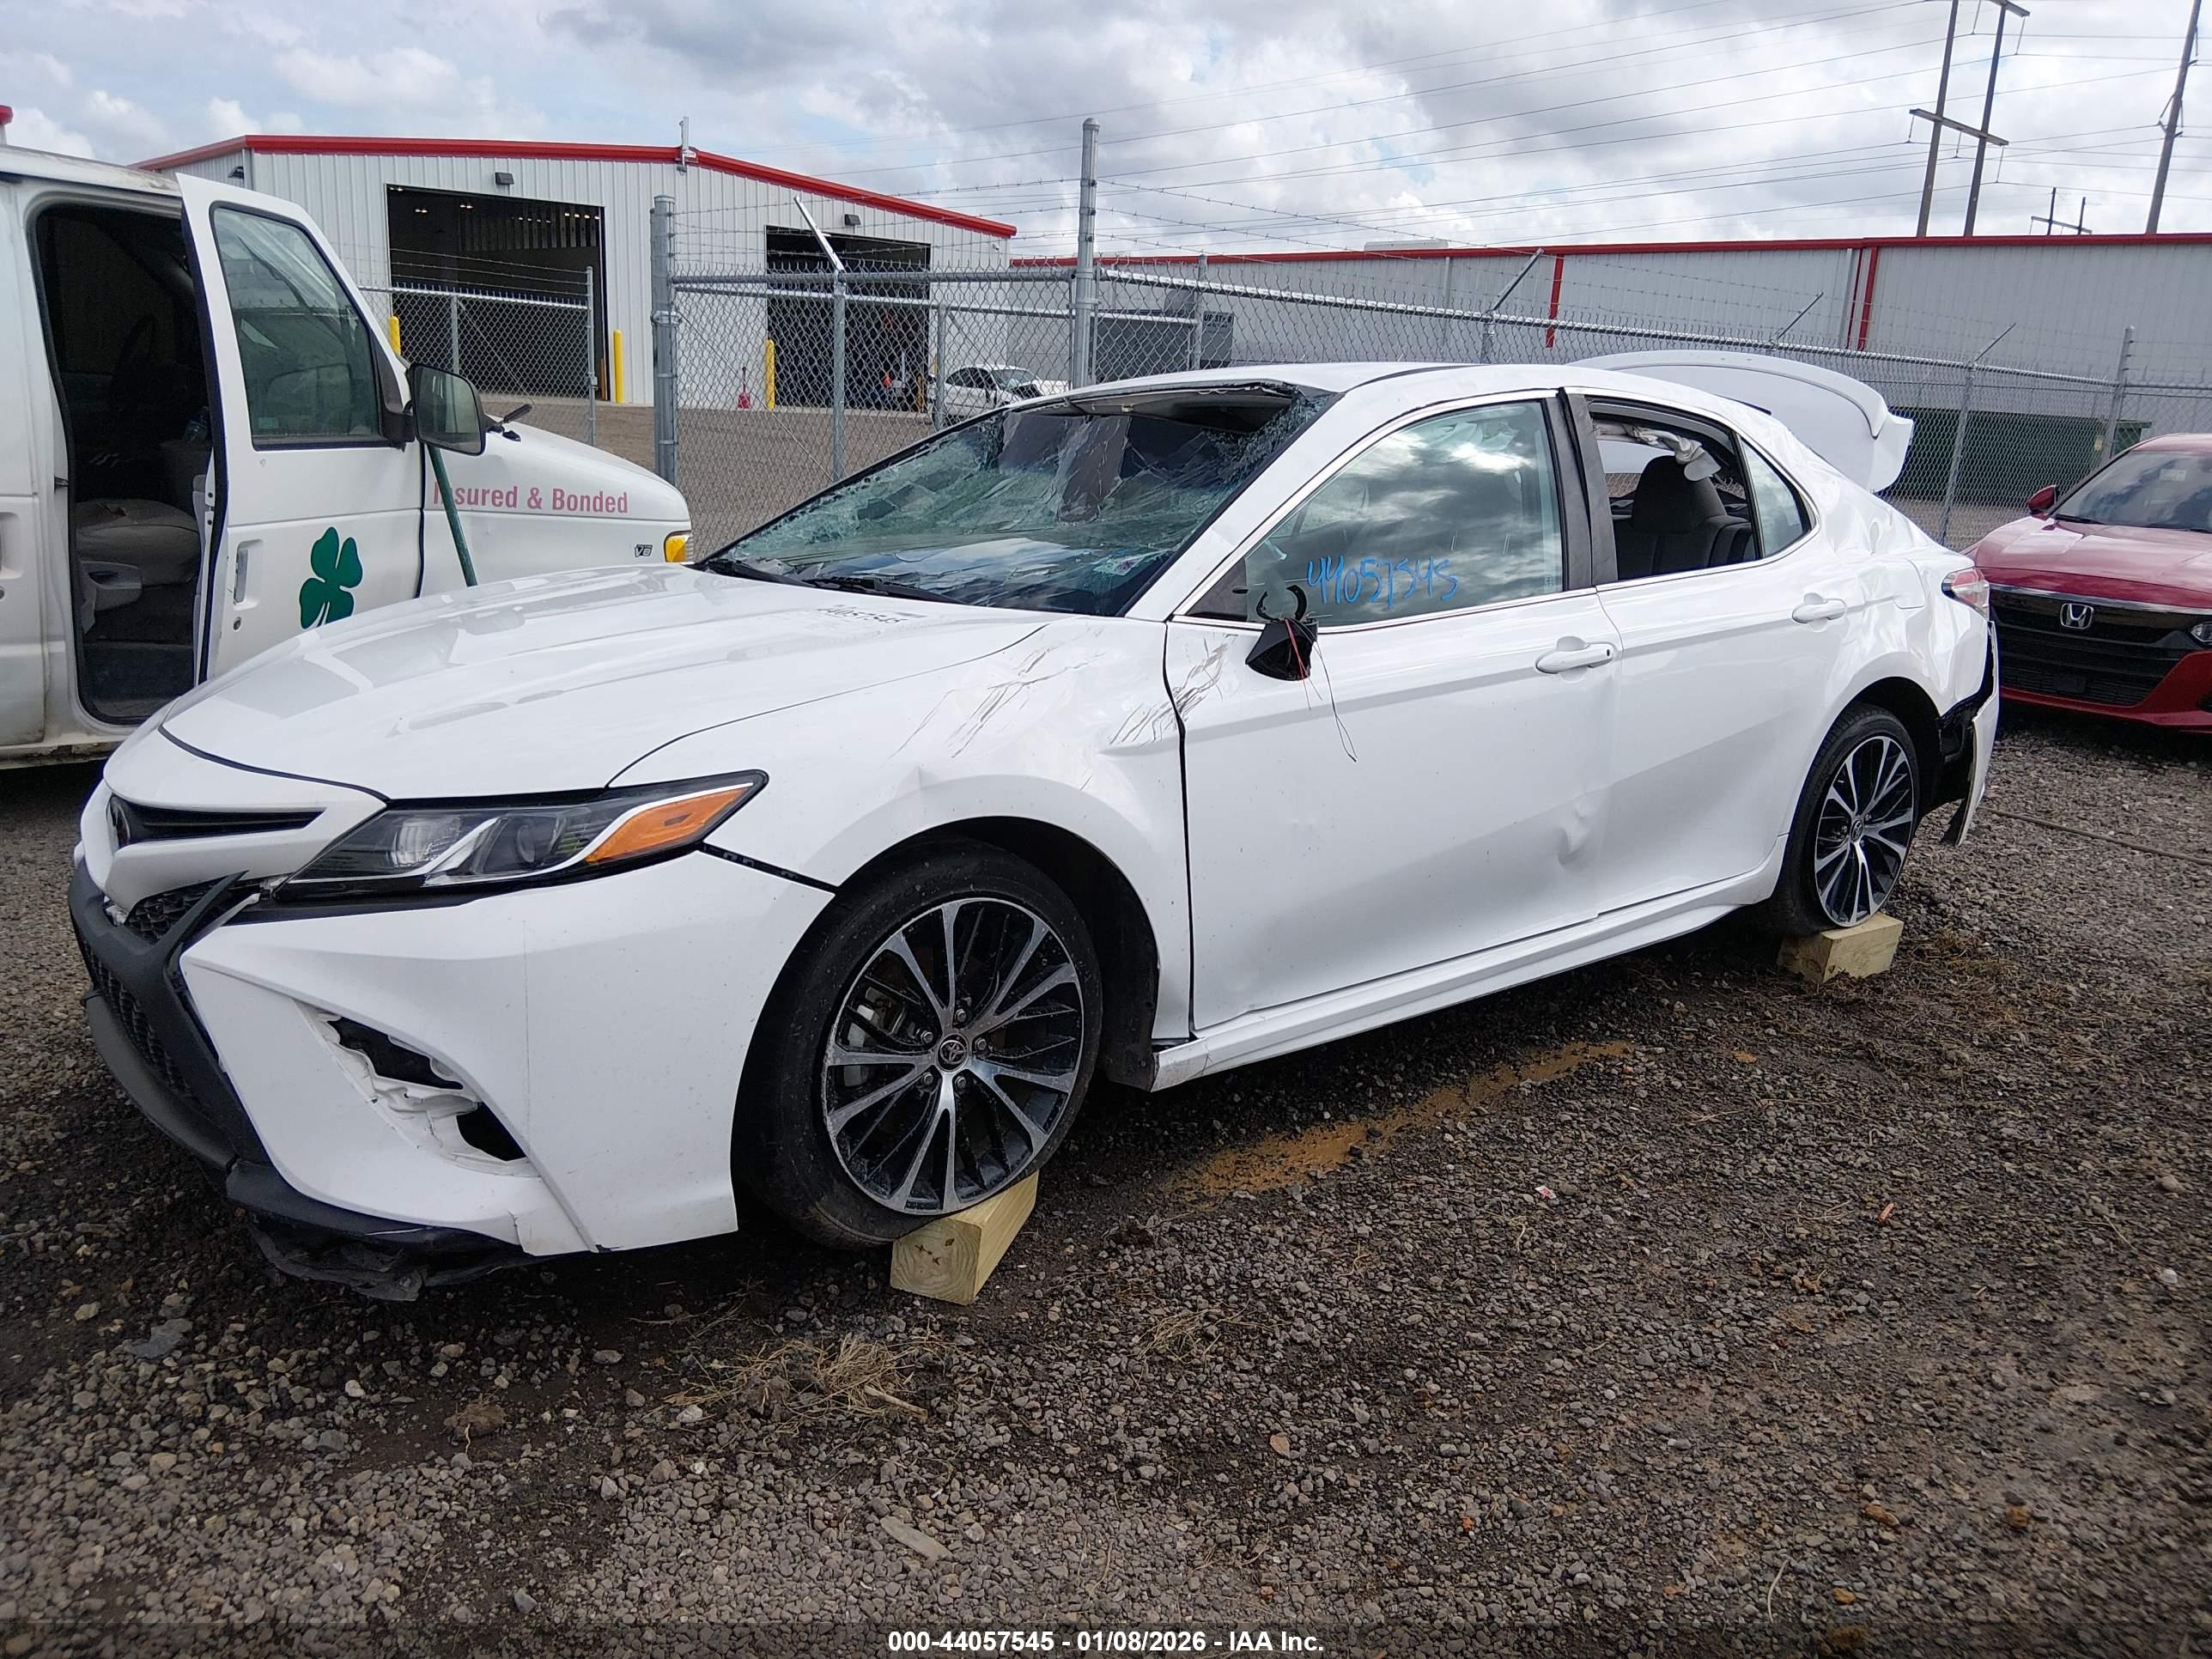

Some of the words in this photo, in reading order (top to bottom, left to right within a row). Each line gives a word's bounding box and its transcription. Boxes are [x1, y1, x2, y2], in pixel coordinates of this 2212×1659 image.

[433, 481, 518, 508] Isured
[526, 487, 543, 509] &
[552, 488, 628, 514] Bonded
[635, 545, 653, 557] V8
[1307, 556, 1459, 610] 44057545
